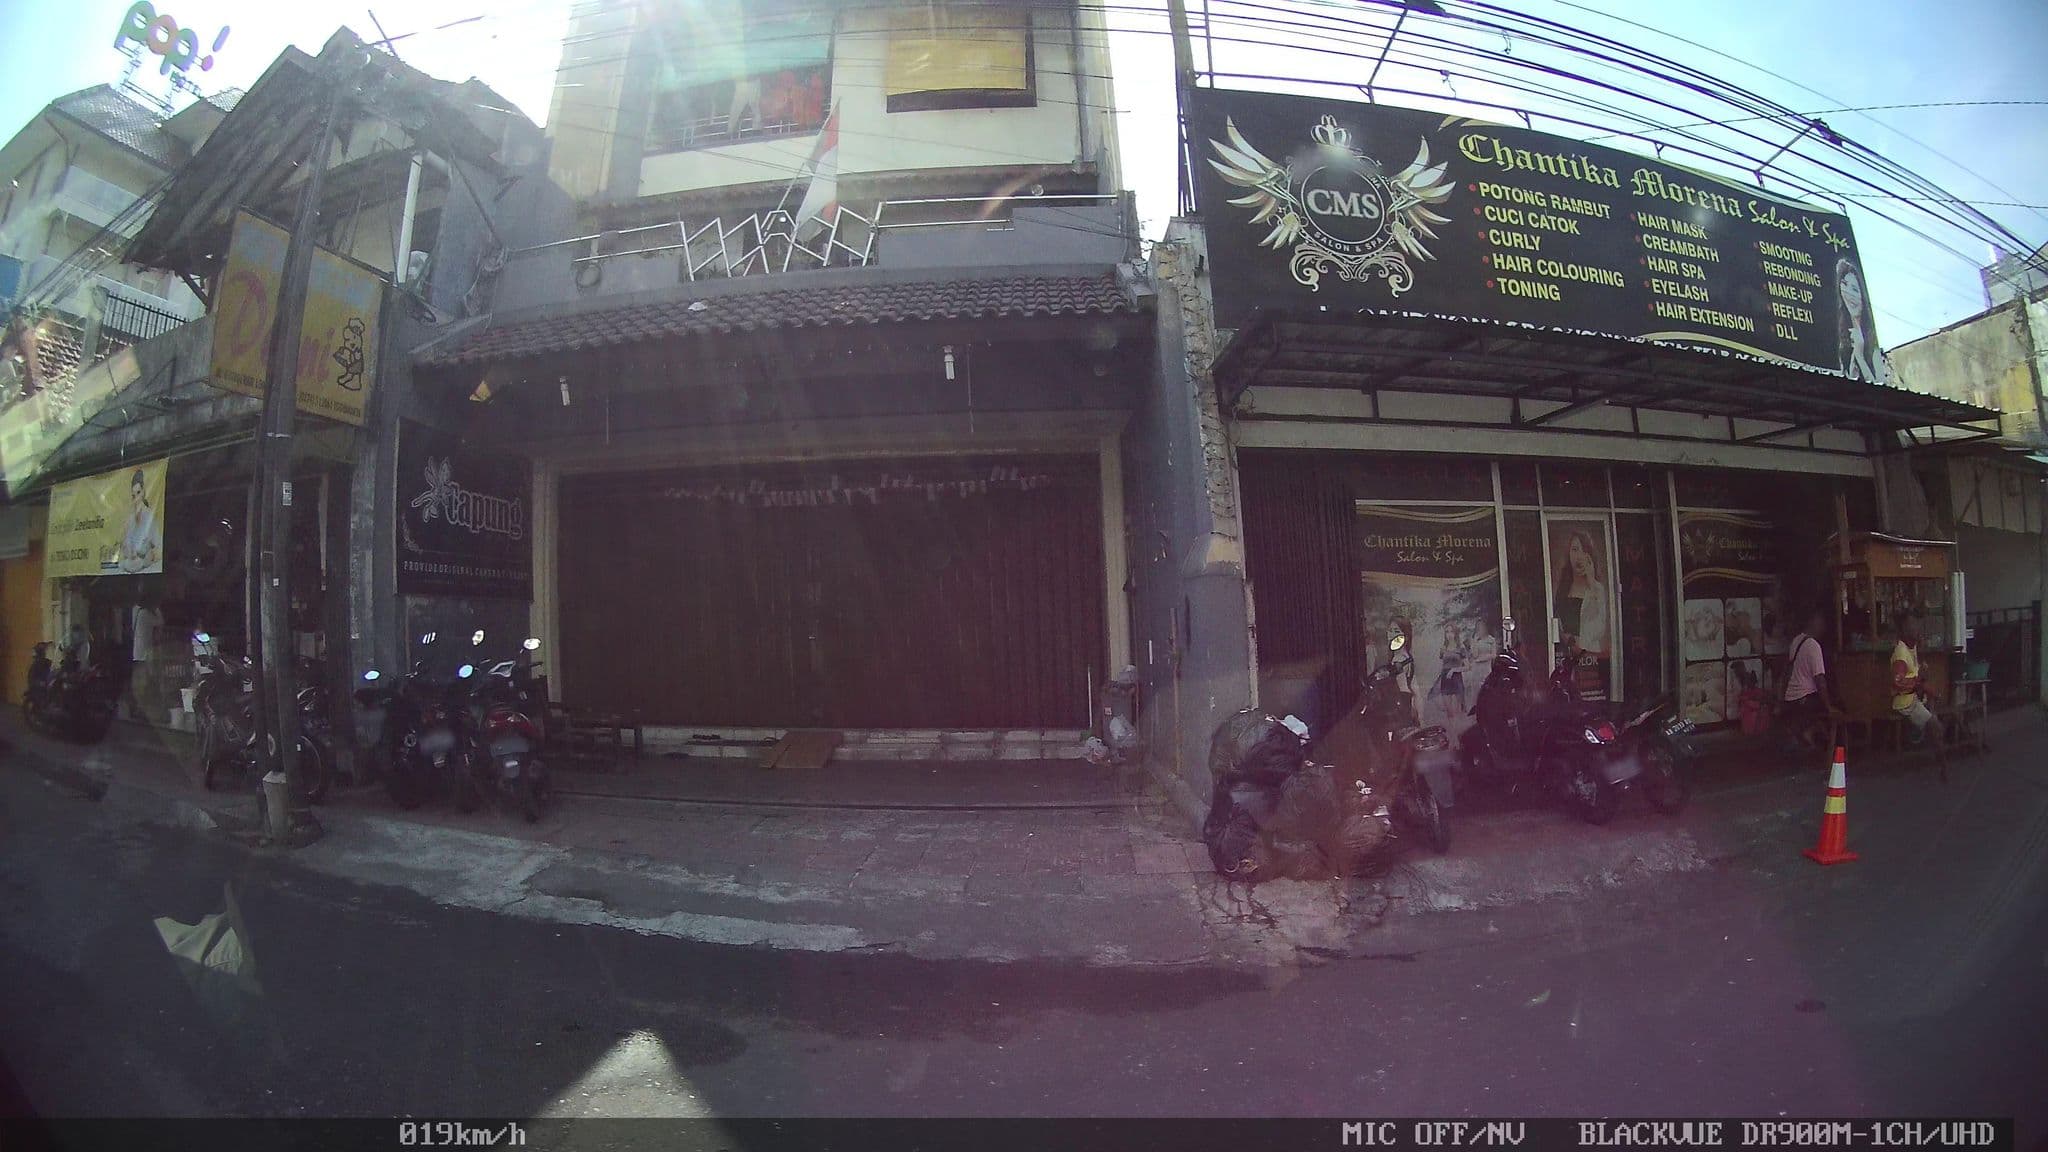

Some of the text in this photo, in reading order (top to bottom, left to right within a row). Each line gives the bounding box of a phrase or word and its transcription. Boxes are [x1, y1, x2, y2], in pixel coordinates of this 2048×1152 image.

[1307, 189, 1380, 219] CMS
[1458, 134, 1621, 188] Chantika
[1631, 167, 1744, 218] Morena
[1748, 200, 1801, 233] Salon
[1822, 223, 1851, 253] Spa
[1478, 181, 1611, 219] POTONG RAMBUT
[1484, 205, 1581, 235] CUCI CATOK
[1637, 211, 1708, 240] HAIR MASK
[1314, 231, 1350, 252] SALON
[1365, 237, 1384, 250] SPA
[1489, 229, 1541, 251] CURLY
[1642, 233, 1720, 262] CREAMBATH
[1759, 240, 1813, 267] SMOOTING
[1493, 253, 1625, 288] HAIR COLOURING
[1647, 256, 1706, 281] HAIR SPA
[1763, 260, 1822, 287] REBONDING
[1496, 277, 1561, 301] TONING
[1651, 278, 1709, 302] EYELASH
[1768, 281, 1814, 304] MAKE-UP
[1656, 301, 1755, 333] HAIR EXTENSION
[1772, 302, 1814, 324] REFLEXI
[1775, 323, 1798, 341] DLL
[1363, 534, 1492, 549] Chantika Morena
[1397, 551, 1430, 564] Salon
[1445, 551, 1465, 566] Spa
